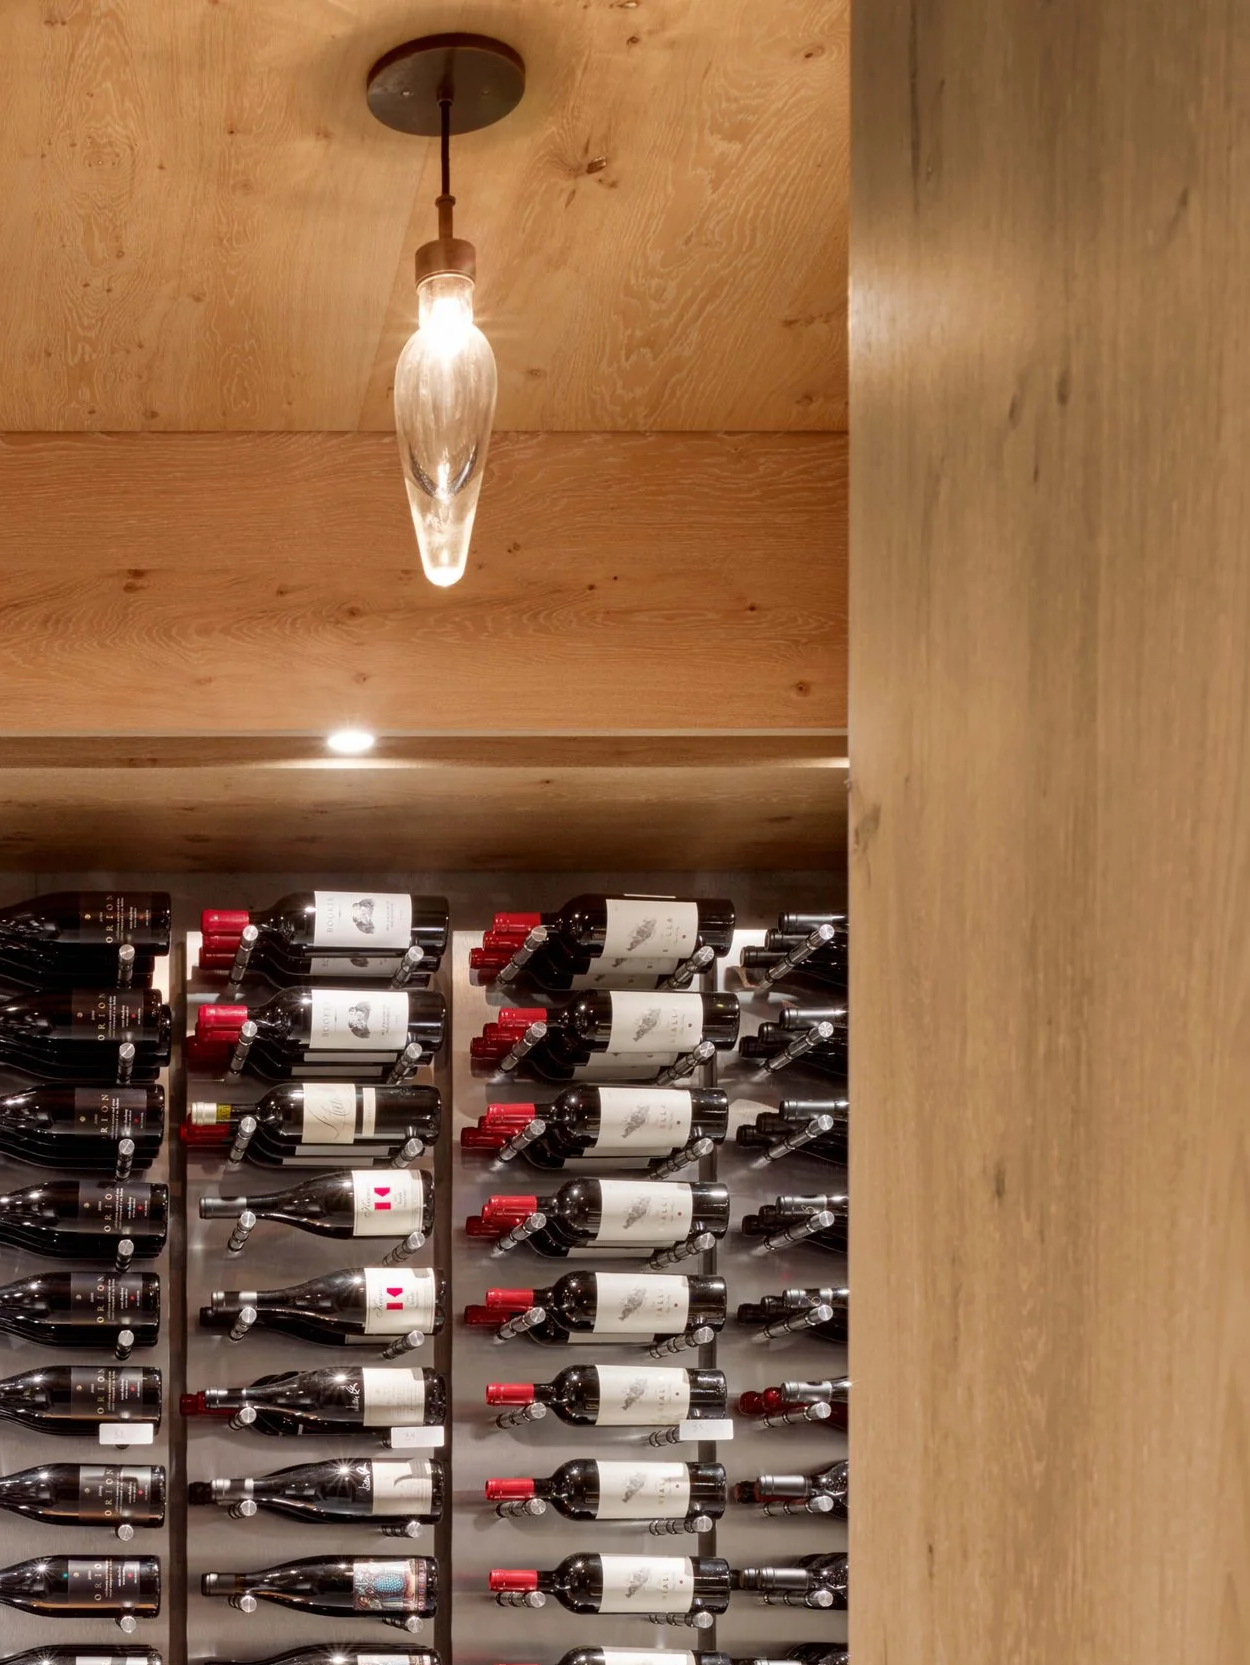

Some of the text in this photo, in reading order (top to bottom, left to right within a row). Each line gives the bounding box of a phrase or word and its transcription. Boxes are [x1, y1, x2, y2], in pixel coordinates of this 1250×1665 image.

[106, 895, 114, 944] ORION
[98, 993, 106, 1040] ORION
[96, 1276, 104, 1324] ORION
[97, 1368, 106, 1415] ORION
[104, 1469, 114, 1517] ORION
